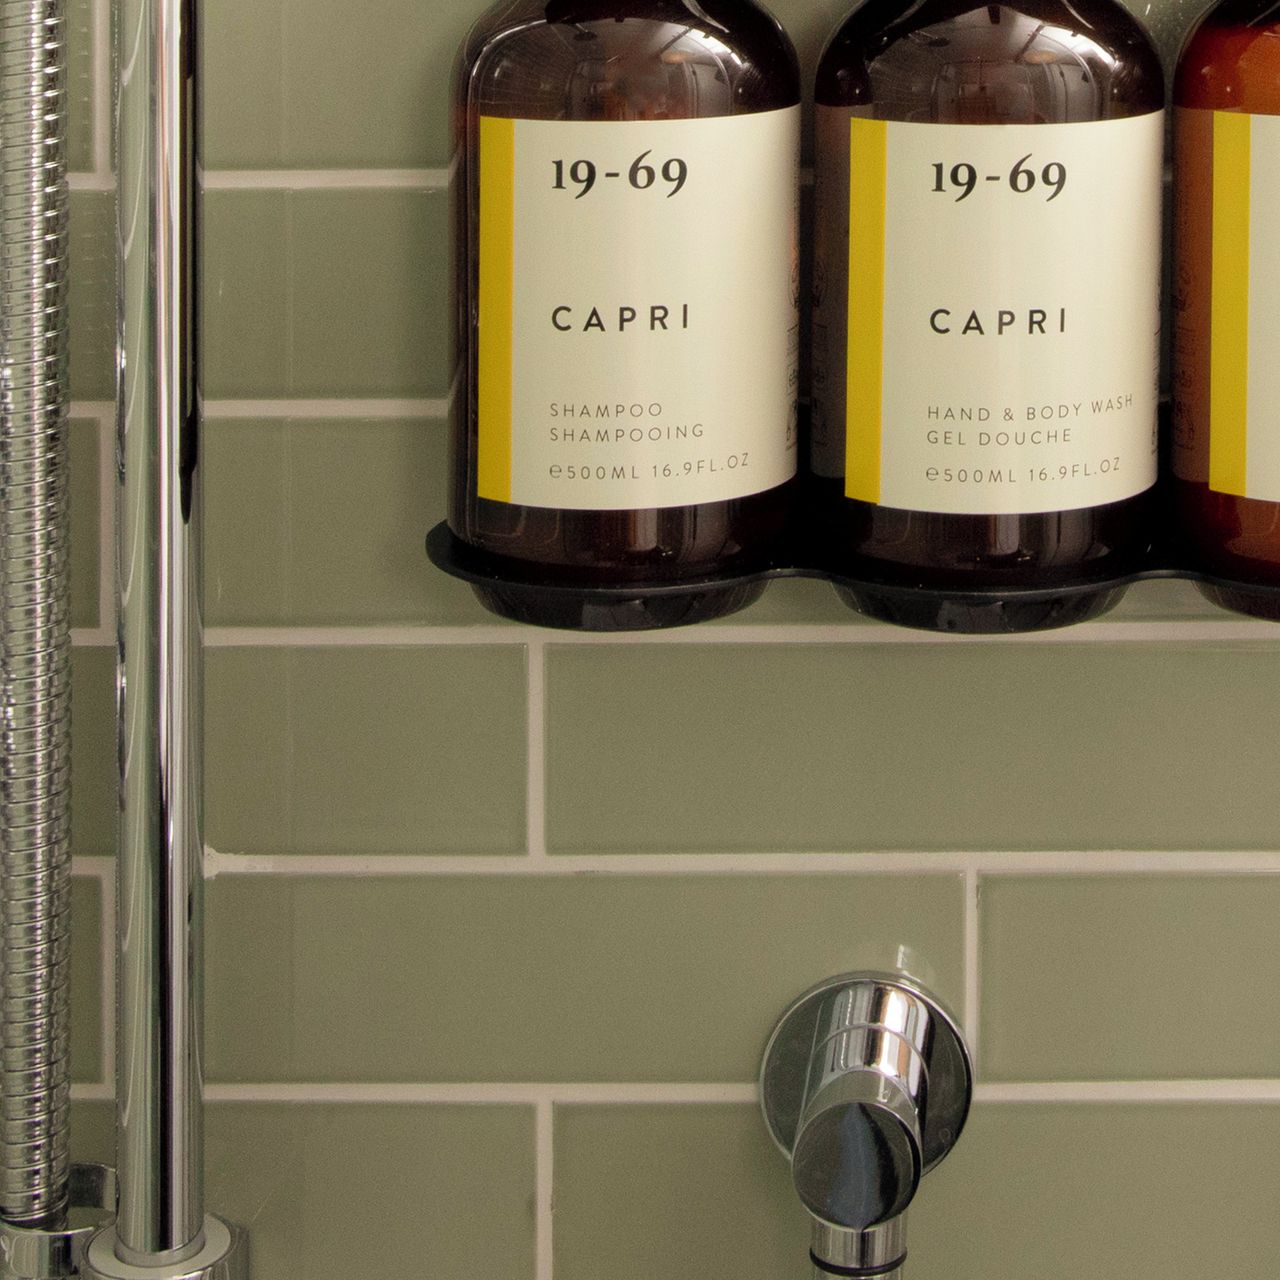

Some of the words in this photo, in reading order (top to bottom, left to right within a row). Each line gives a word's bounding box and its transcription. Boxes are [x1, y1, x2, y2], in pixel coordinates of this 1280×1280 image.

[552, 149, 688, 200] 19-69
[931, 153, 1067, 203] 19-69
[551, 303, 688, 332] CAPRI
[929, 307, 1065, 336] CAPRI
[549, 402, 663, 419] SHAMPOO
[927, 406, 991, 422] HAND
[1003, 407, 1015, 422] &
[1026, 402, 1082, 421] BODY
[1091, 393, 1133, 414] WASH
[549, 423, 704, 443] SHAMPOOING
[926, 429, 966, 446] GEL
[978, 428, 1071, 447] DOUCHE
